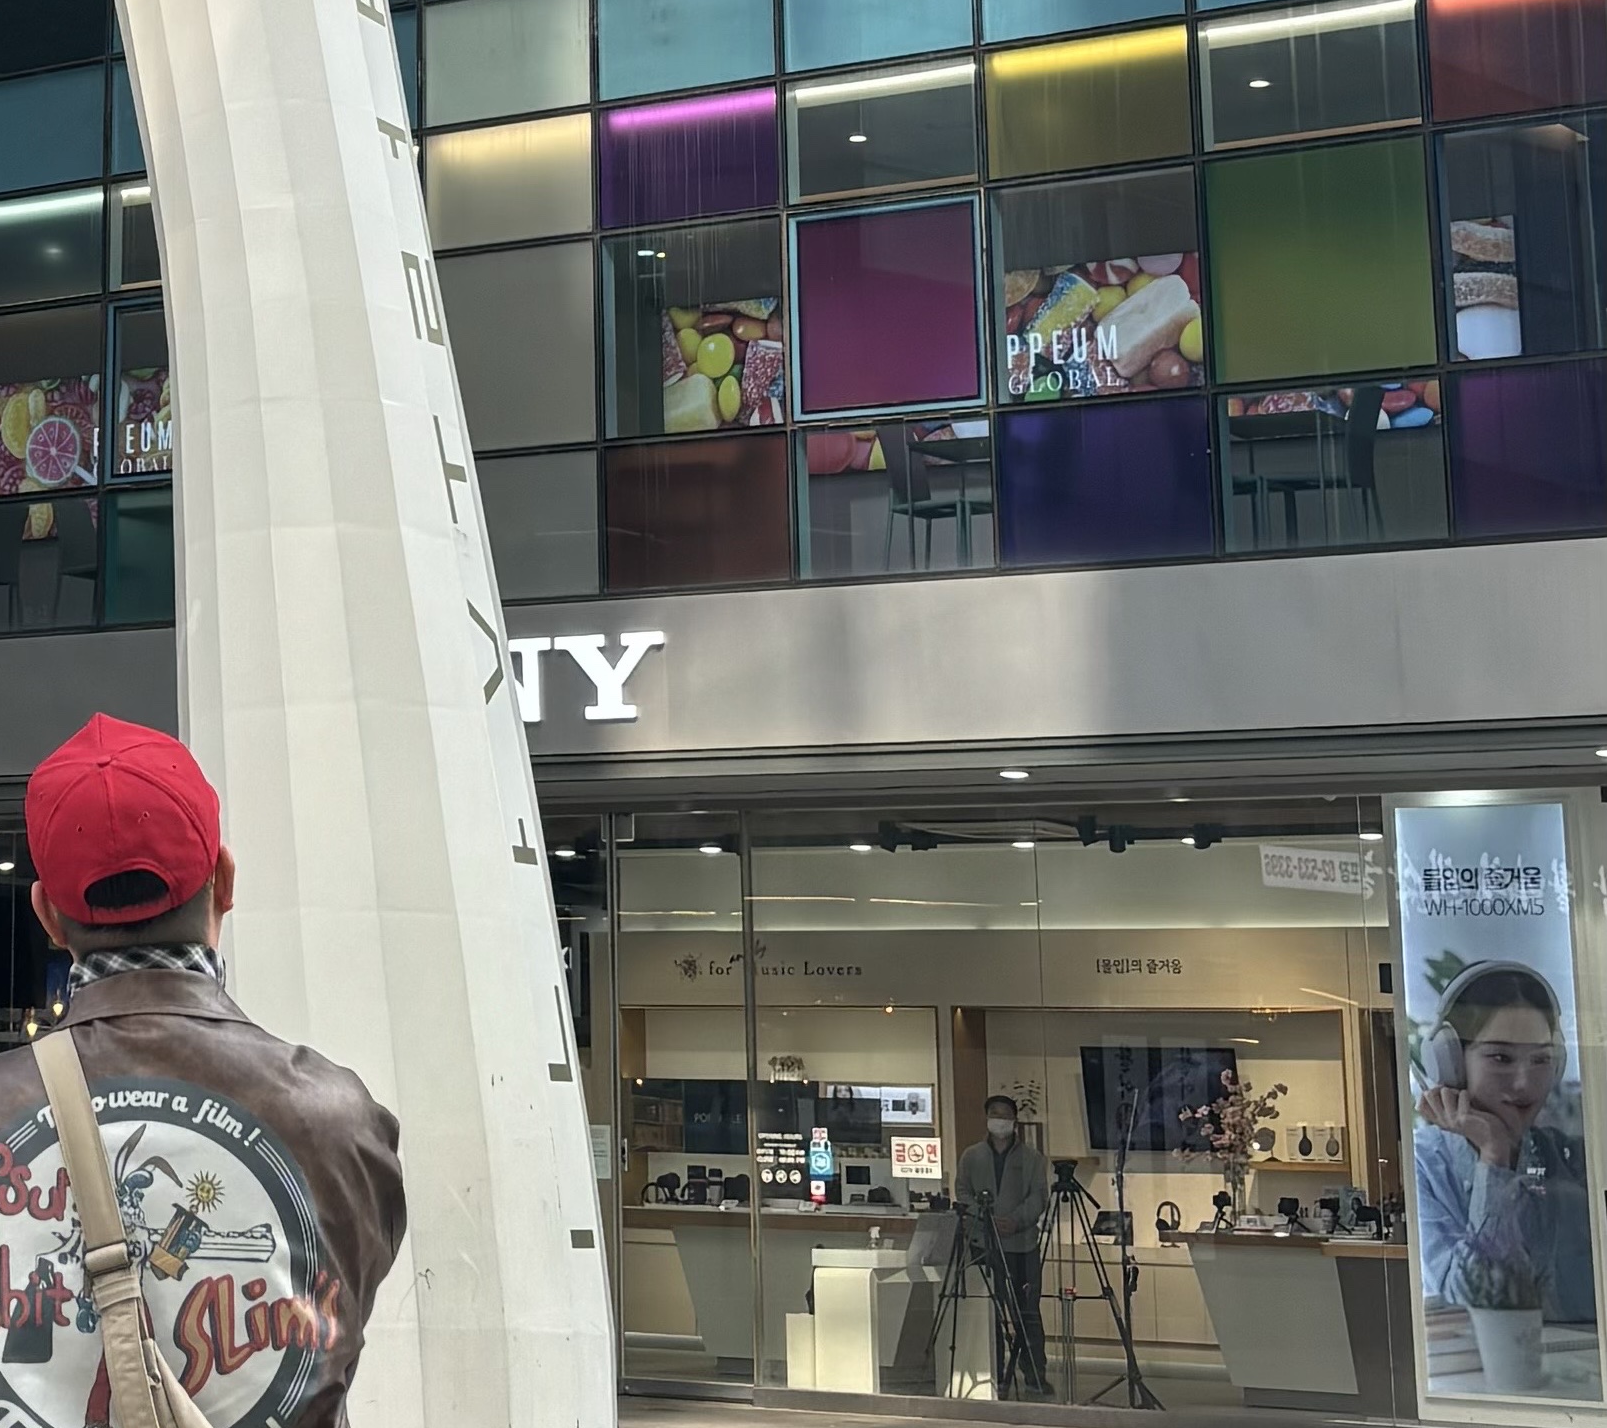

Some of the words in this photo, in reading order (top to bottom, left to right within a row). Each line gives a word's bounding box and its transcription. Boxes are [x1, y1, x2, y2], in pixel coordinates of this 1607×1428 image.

[1006, 324, 1119, 369] PPEUM
[1008, 365, 1121, 395] GLOBAL
[1423, 897, 1546, 917] WH-1000XM5
[709, 960, 733, 976] for
[758, 961, 795, 976] usic
[803, 960, 863, 976] Lovers
[108, 1088, 169, 1109] wear
[171, 1095, 189, 1113] a
